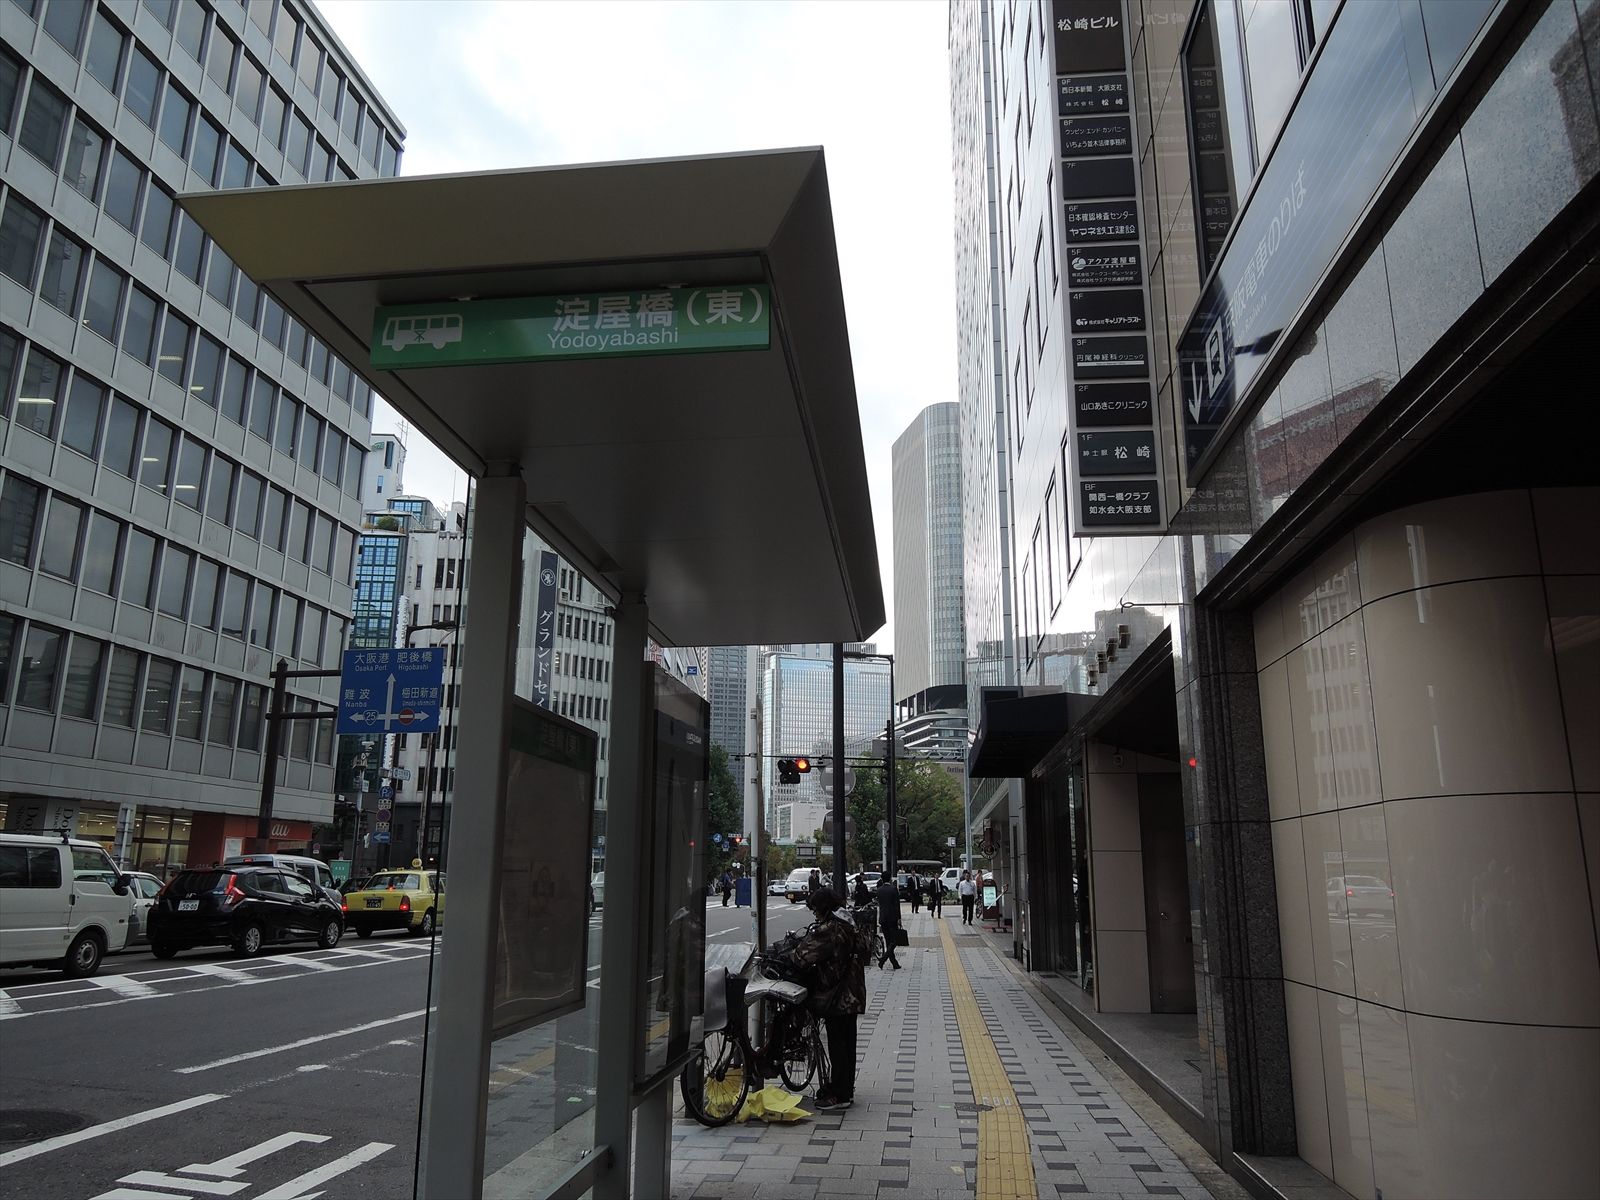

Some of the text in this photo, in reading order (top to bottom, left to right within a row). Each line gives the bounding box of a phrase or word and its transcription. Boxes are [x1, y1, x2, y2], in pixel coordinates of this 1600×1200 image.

[1057, 15, 1120, 31] 松崎ビル
[1061, 83, 1123, 94] 西日本新聞 大阪支社
[1068, 211, 1135, 223] 日本確認検査センター
[1069, 224, 1136, 237] ヤマネ鉄工建設
[1071, 248, 1082, 256] 5F
[1072, 292, 1084, 300] 4F
[547, 327, 679, 351] Yodoyabashi
[1076, 338, 1088, 346] 3F
[1078, 384, 1089, 392] 2F
[1080, 400, 1148, 411] 山口あきこクリニック
[1081, 433, 1093, 441] 1F
[1088, 491, 1151, 502] 関西一橋クラブ
[1089, 504, 1152, 515] 如水会大阪支部
[354, 651, 433, 664] 大阪港 肥後橋
[398, 664, 429, 672] Higobashi
[344, 688, 371, 700] 難波
[366, 711, 376, 721] 25
[271, 823, 290, 837] au
